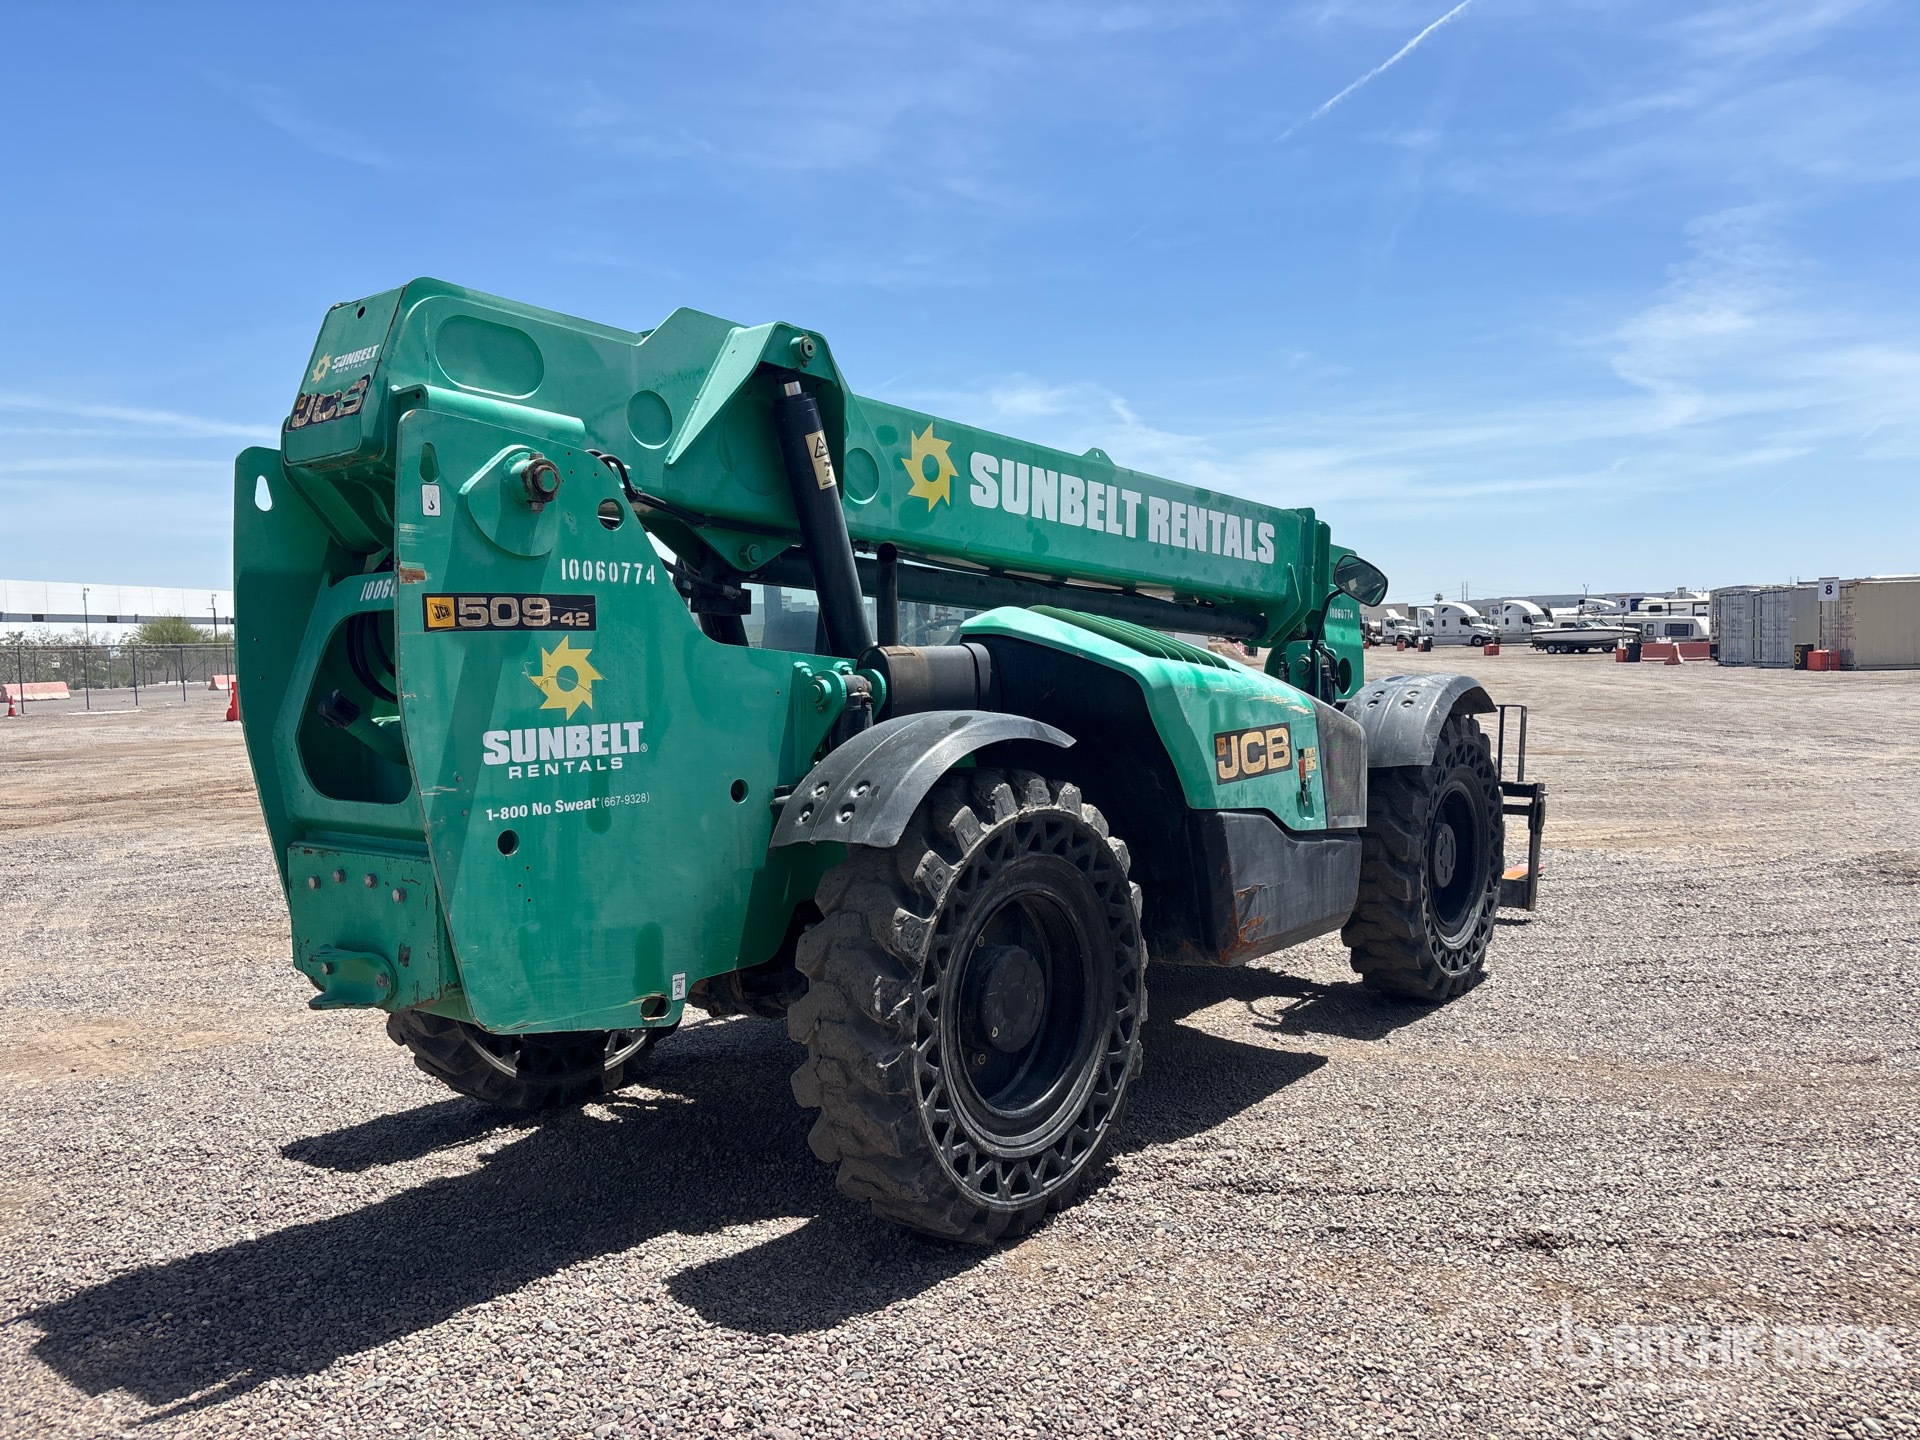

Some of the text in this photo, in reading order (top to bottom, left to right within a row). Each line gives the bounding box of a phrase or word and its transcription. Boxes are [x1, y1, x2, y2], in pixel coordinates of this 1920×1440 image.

[332, 344, 379, 370] SUNBELT
[291, 379, 369, 428] JCB
[969, 451, 1275, 564] SUNBELT RENTALS
[561, 558, 656, 585] 10060774
[1825, 584, 1833, 595] 8
[434, 604, 451, 620] JCB
[1329, 607, 1354, 620] 10060774
[1491, 608, 1499, 616] 10
[1620, 600, 1626, 609] 9
[482, 721, 644, 766] SUNBELT
[1217, 727, 1291, 780] JCB
[508, 756, 624, 780] RENTALS
[486, 804, 528, 821] 1-800
[532, 802, 551, 816] No
[601, 791, 650, 809] (667-9328)
